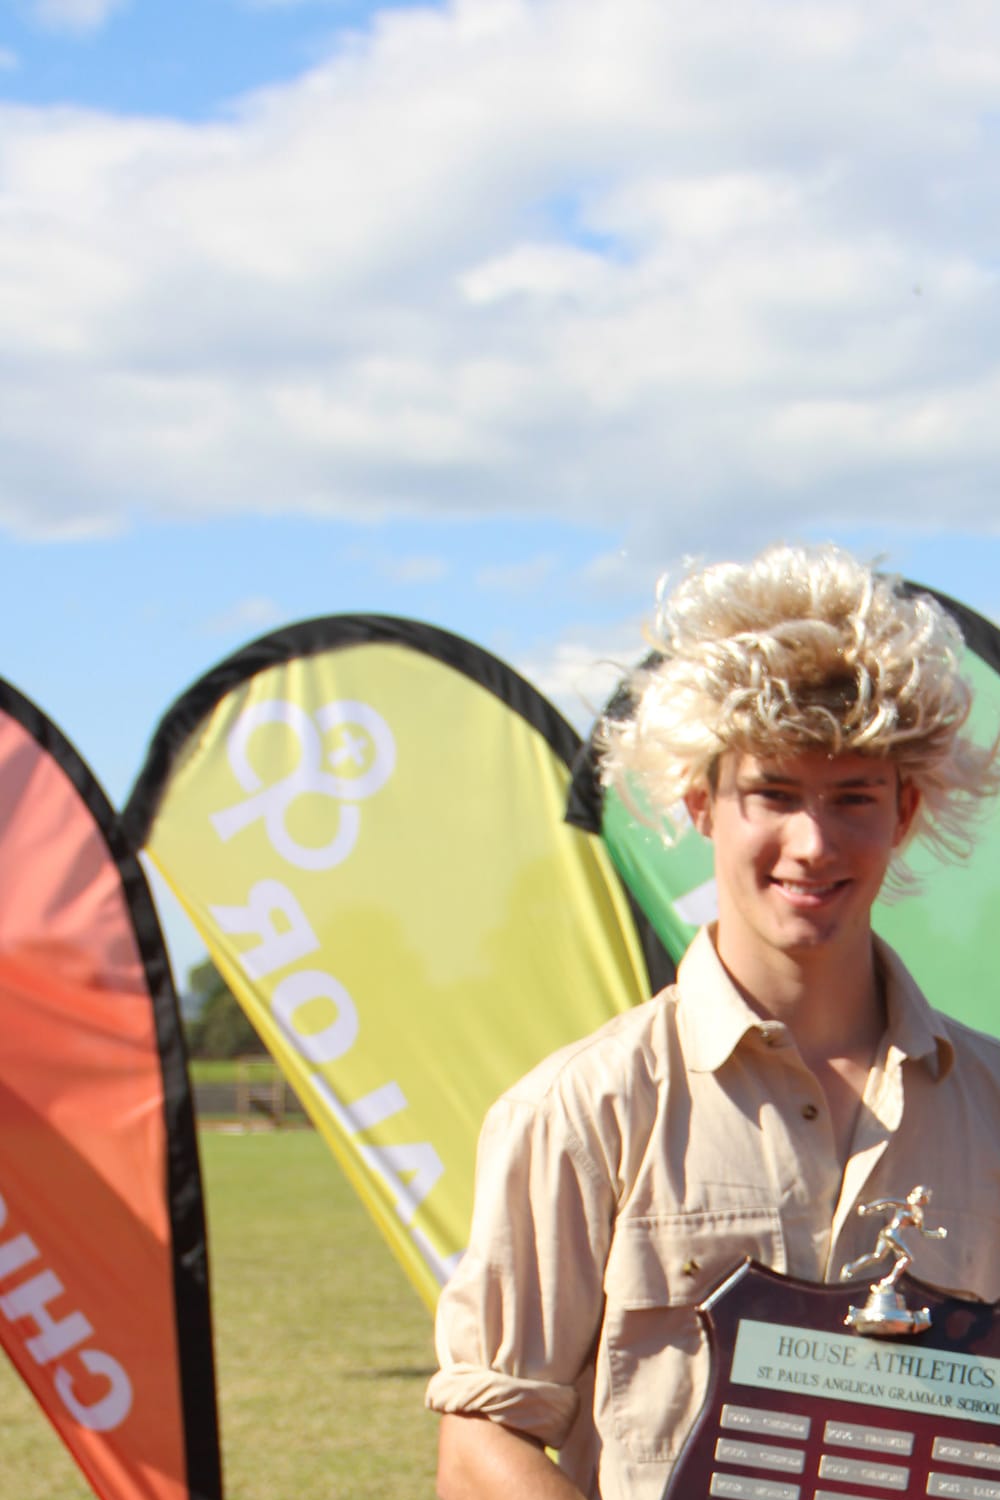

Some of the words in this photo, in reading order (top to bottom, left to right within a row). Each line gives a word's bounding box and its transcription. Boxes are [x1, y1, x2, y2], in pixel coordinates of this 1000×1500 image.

[777, 1335, 857, 1367] HOUSE
[863, 1351, 996, 1389] ATHLETICS
[822, 1376, 885, 1398] ANGLICAN
[888, 1387, 954, 1407] GRAMMAR
